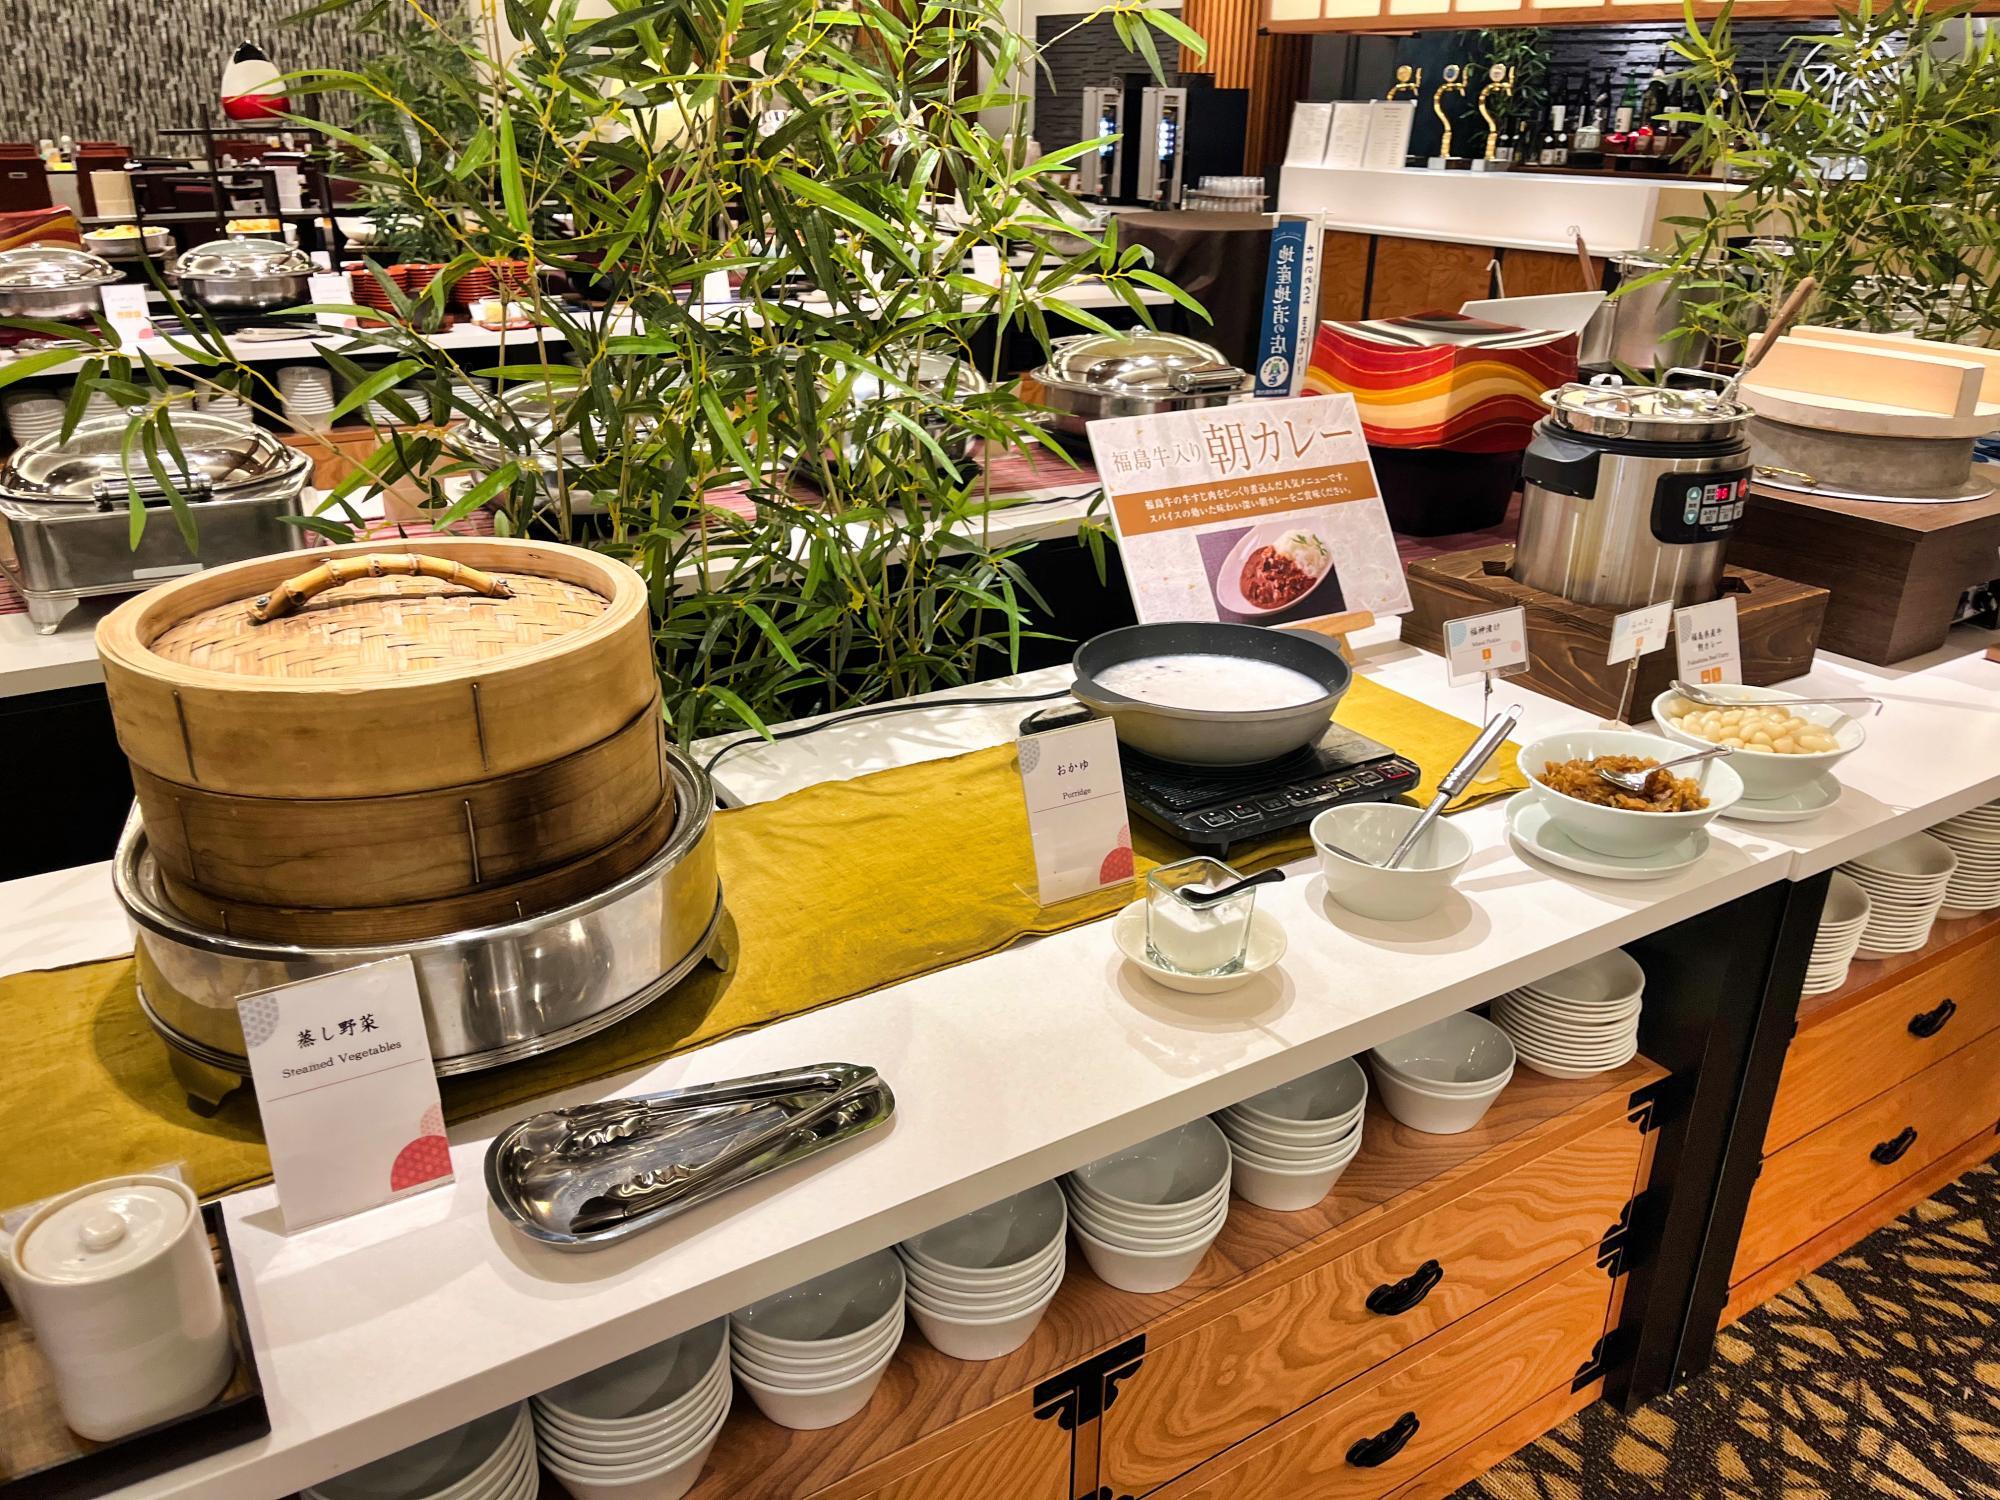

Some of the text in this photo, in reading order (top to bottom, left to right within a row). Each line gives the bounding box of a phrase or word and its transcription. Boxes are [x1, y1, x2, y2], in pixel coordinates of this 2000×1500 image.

[1057, 759, 1089, 776] おかゆ
[1062, 787, 1092, 800] Porridge
[297, 1013, 379, 1049] 蒸し野菜
[282, 1040, 402, 1079] Steamed Vegetables
